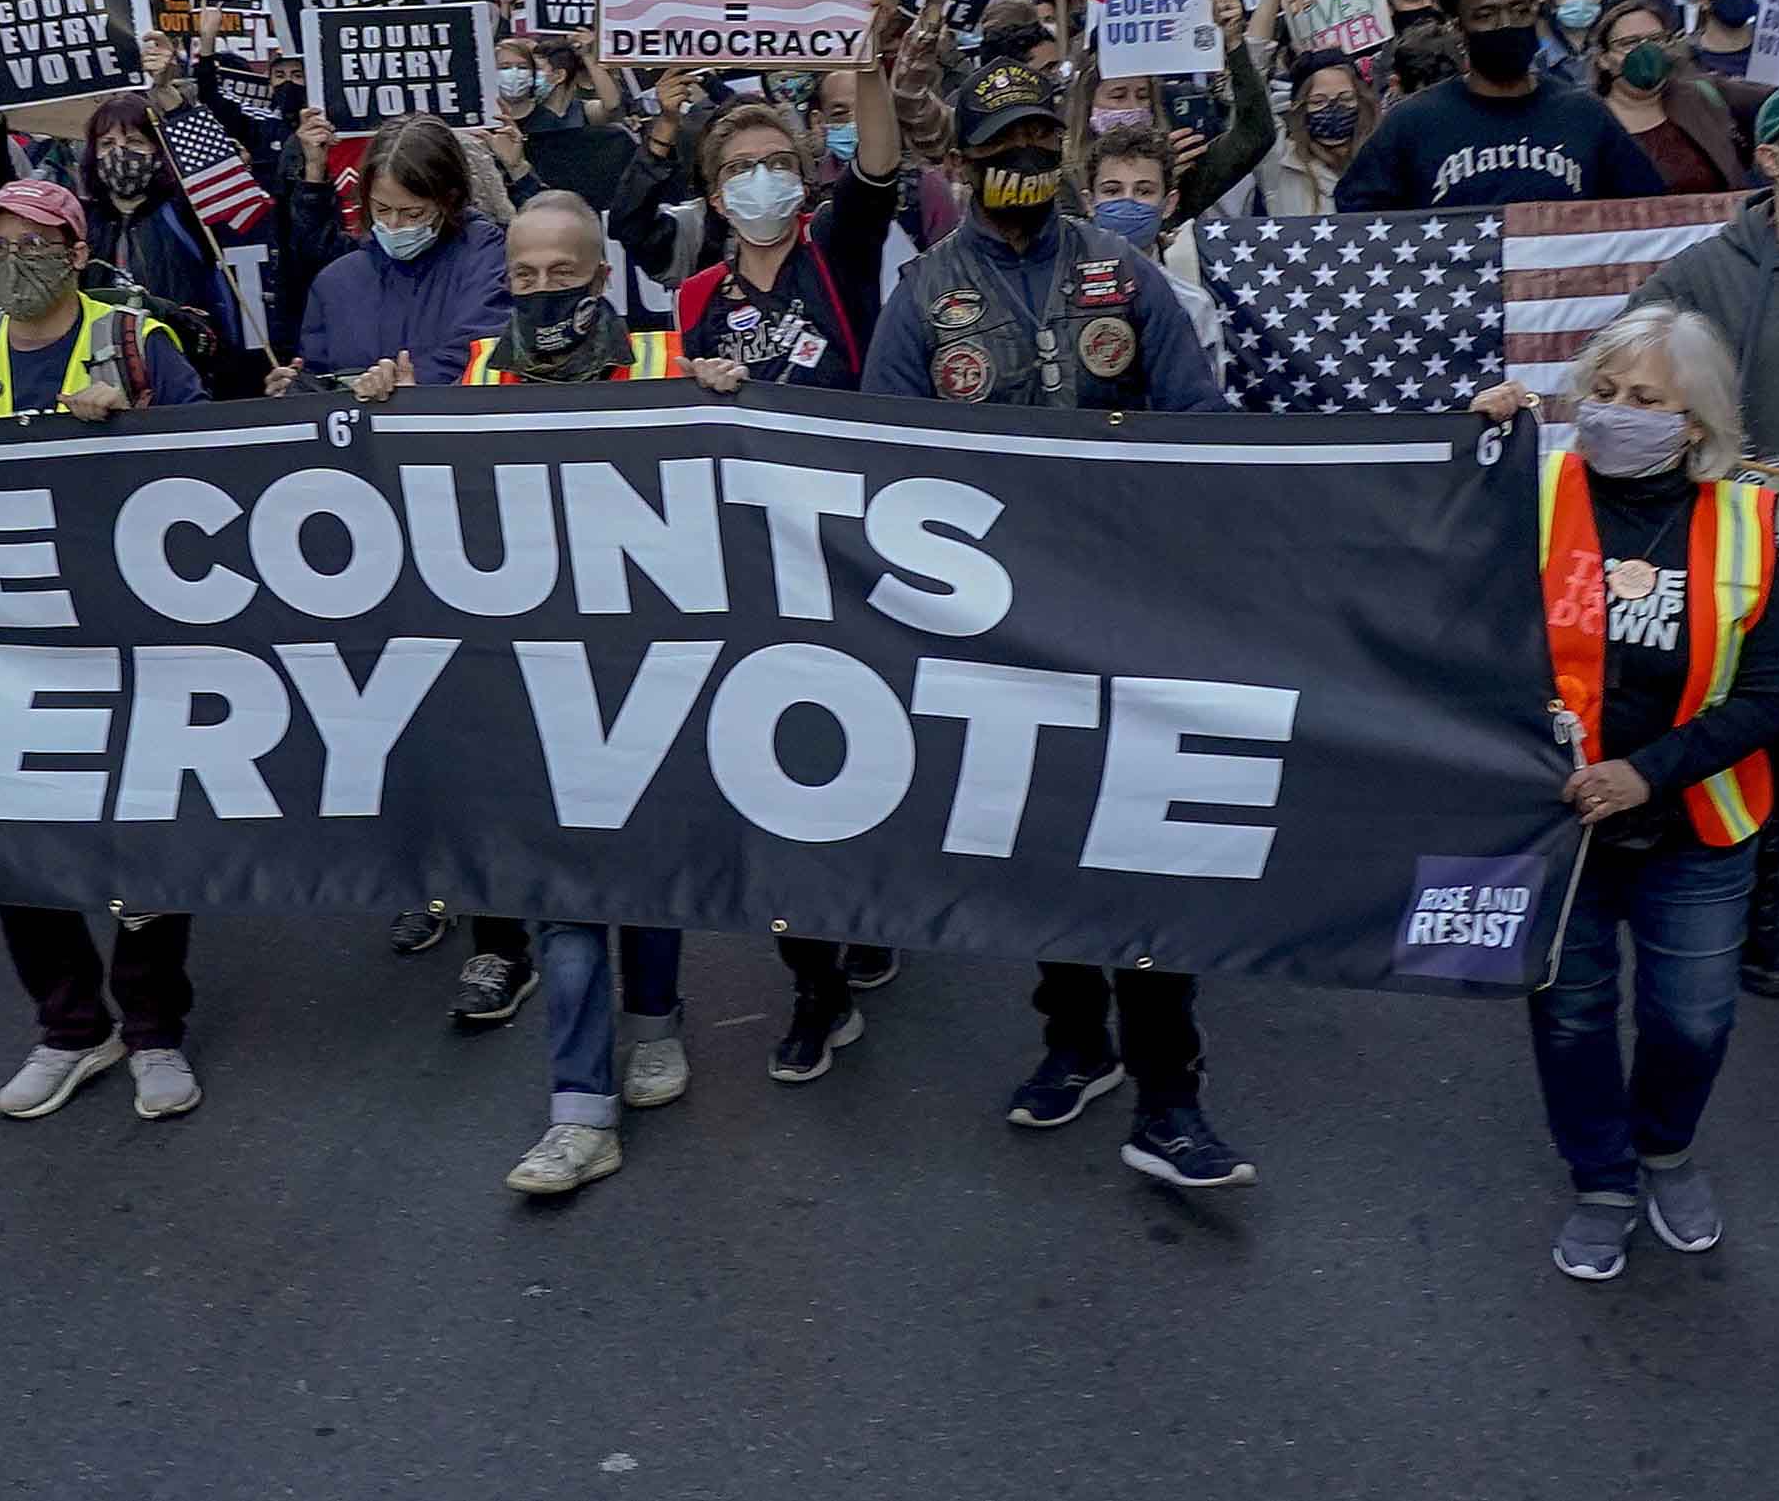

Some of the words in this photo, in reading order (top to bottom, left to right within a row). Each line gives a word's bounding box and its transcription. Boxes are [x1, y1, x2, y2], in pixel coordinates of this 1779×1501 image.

[159, 13, 190, 31] OUT
[546, 5, 595, 25] VOT
[1107, 20, 1174, 45] VOTE
[338, 23, 451, 50] COUNT
[612, 29, 863, 57] DEMOCRACY
[5, 46, 121, 90] VOTE
[341, 49, 452, 81] EVERY
[343, 82, 460, 117] VOTE
[983, 166, 1063, 209] MARINE
[1431, 136, 1583, 205] Maricón
[327, 408, 363, 448] 6'
[1478, 419, 1516, 468] 6'
[112, 456, 1013, 640] COUNTS
[512, 640, 1301, 882] VOTE
[1415, 885, 1473, 912] RISE
[1474, 886, 1530, 913] AND
[1407, 912, 1525, 948] RESIST
